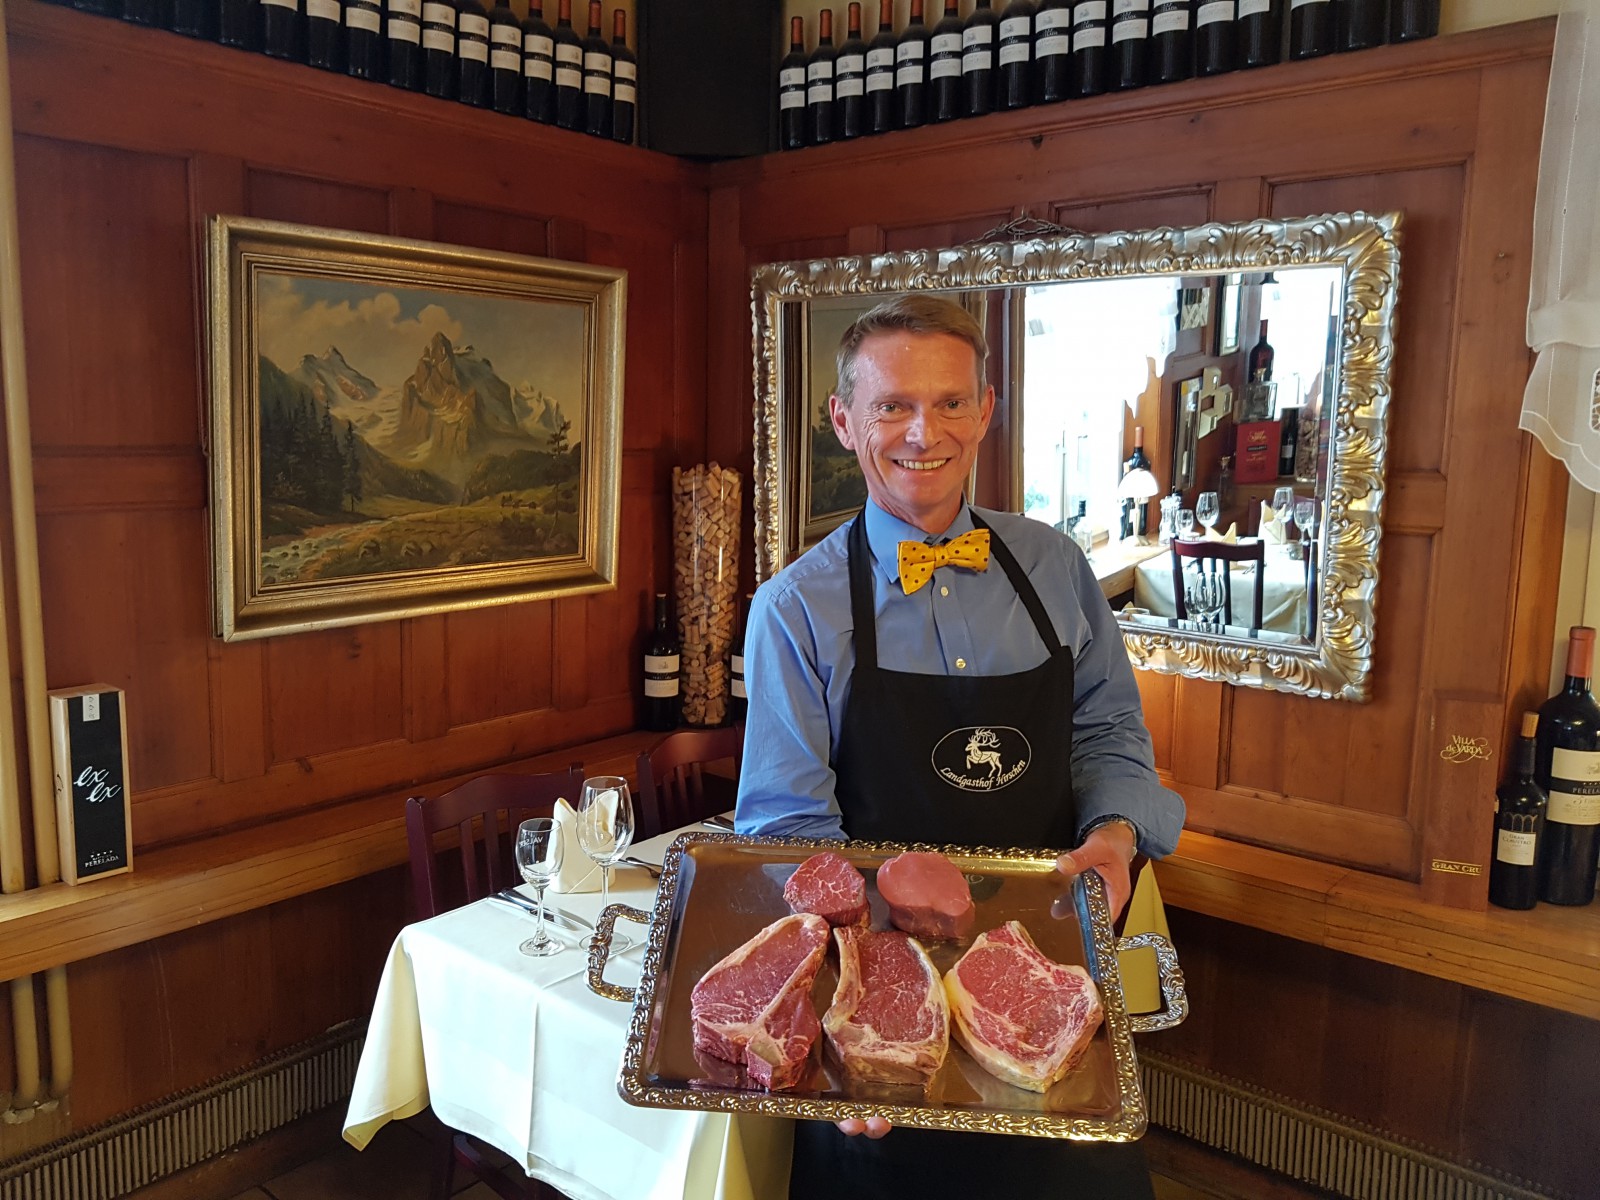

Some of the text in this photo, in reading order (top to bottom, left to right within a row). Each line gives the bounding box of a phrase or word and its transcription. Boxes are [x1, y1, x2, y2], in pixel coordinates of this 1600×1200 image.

[73, 765, 110, 787] ex
[940, 759, 1026, 790] Landgasthof Hirschen
[86, 782, 121, 803] ex
[84, 855, 119, 868] PERELADA
[1432, 861, 1482, 873] GRAN CRU
